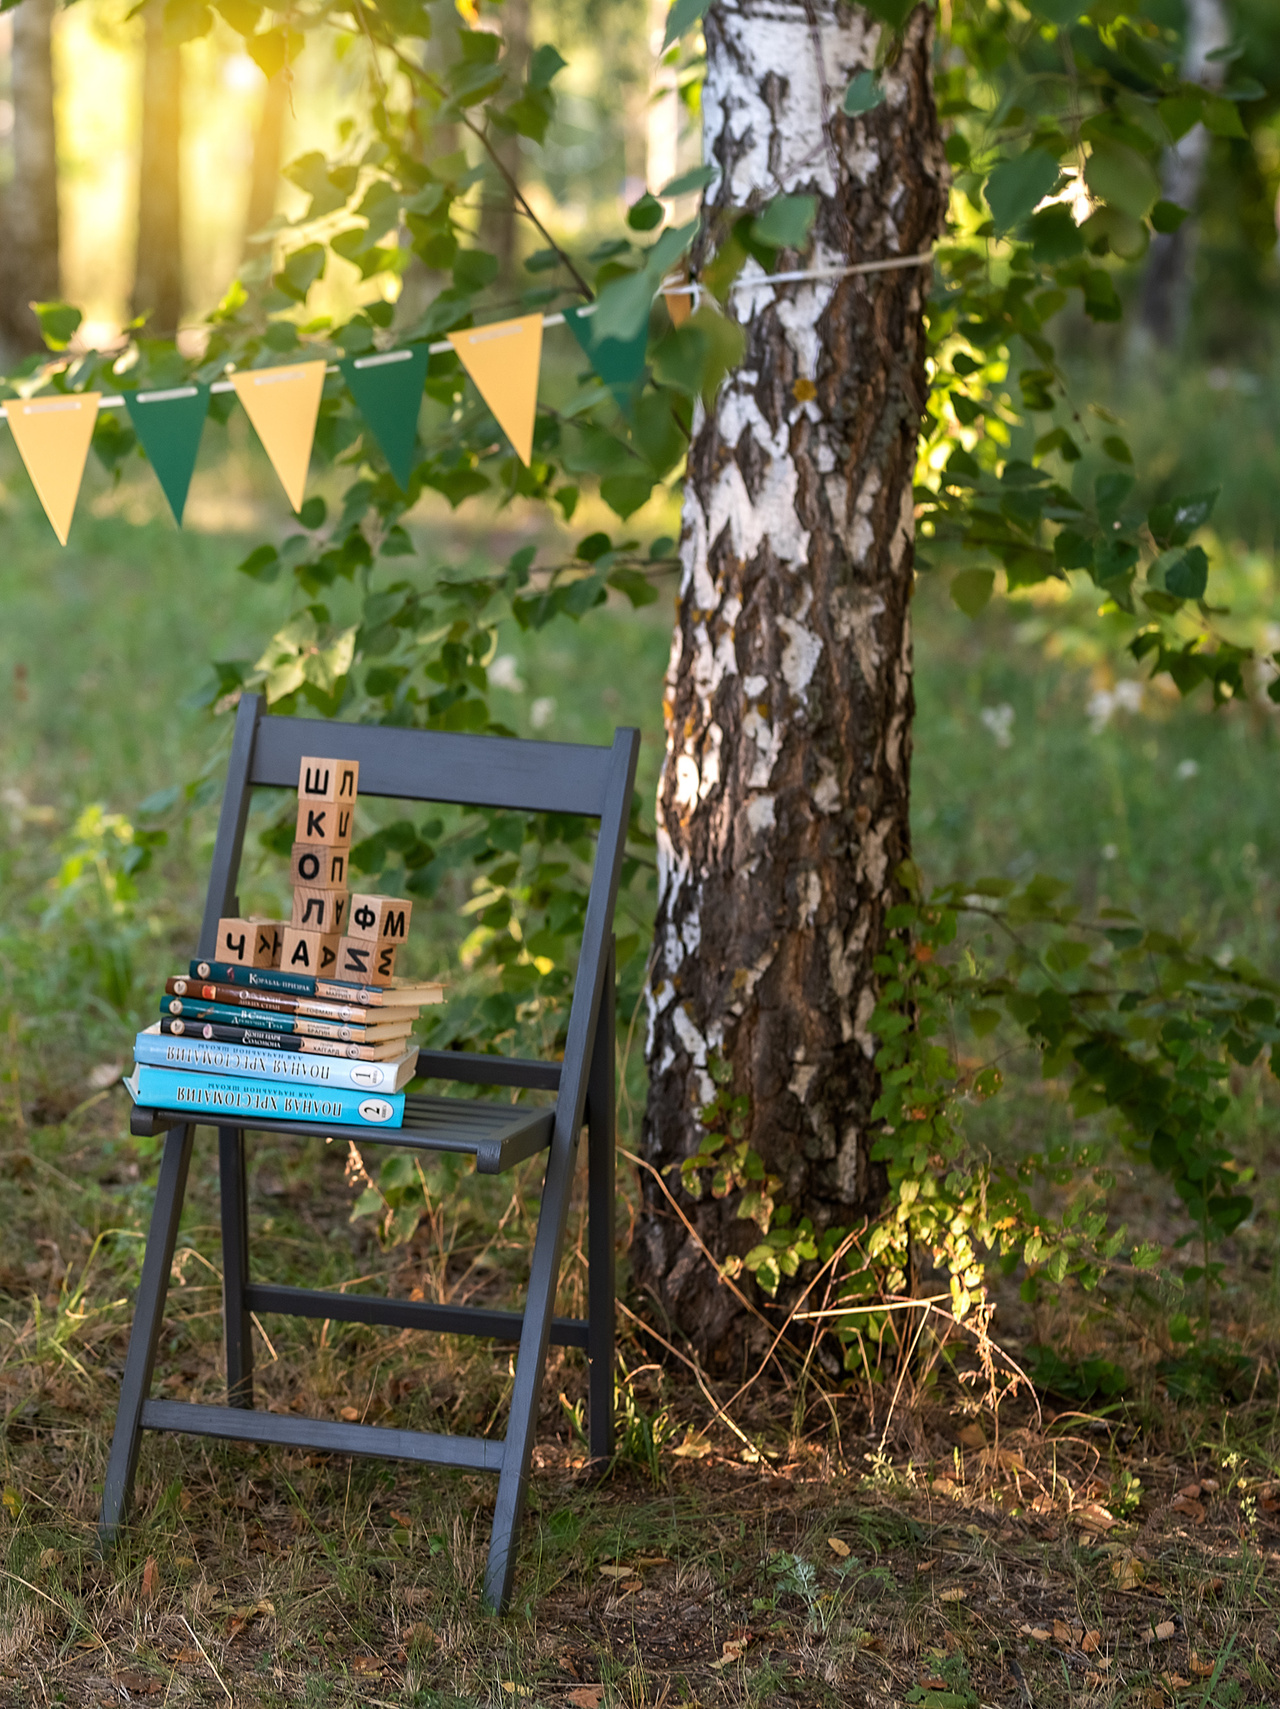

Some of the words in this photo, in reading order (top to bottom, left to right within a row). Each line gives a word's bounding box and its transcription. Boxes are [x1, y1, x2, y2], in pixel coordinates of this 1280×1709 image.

[166, 1046, 266, 1072] ХРЕСТОМАТИЯ
[272, 1060, 330, 1080] ПОЛНАЯ
[176, 1086, 278, 1111] ХРЕСТОМАТИЯ
[283, 1098, 342, 1117] ПОЛНАЯ
[363, 1106, 380, 1115] 2
